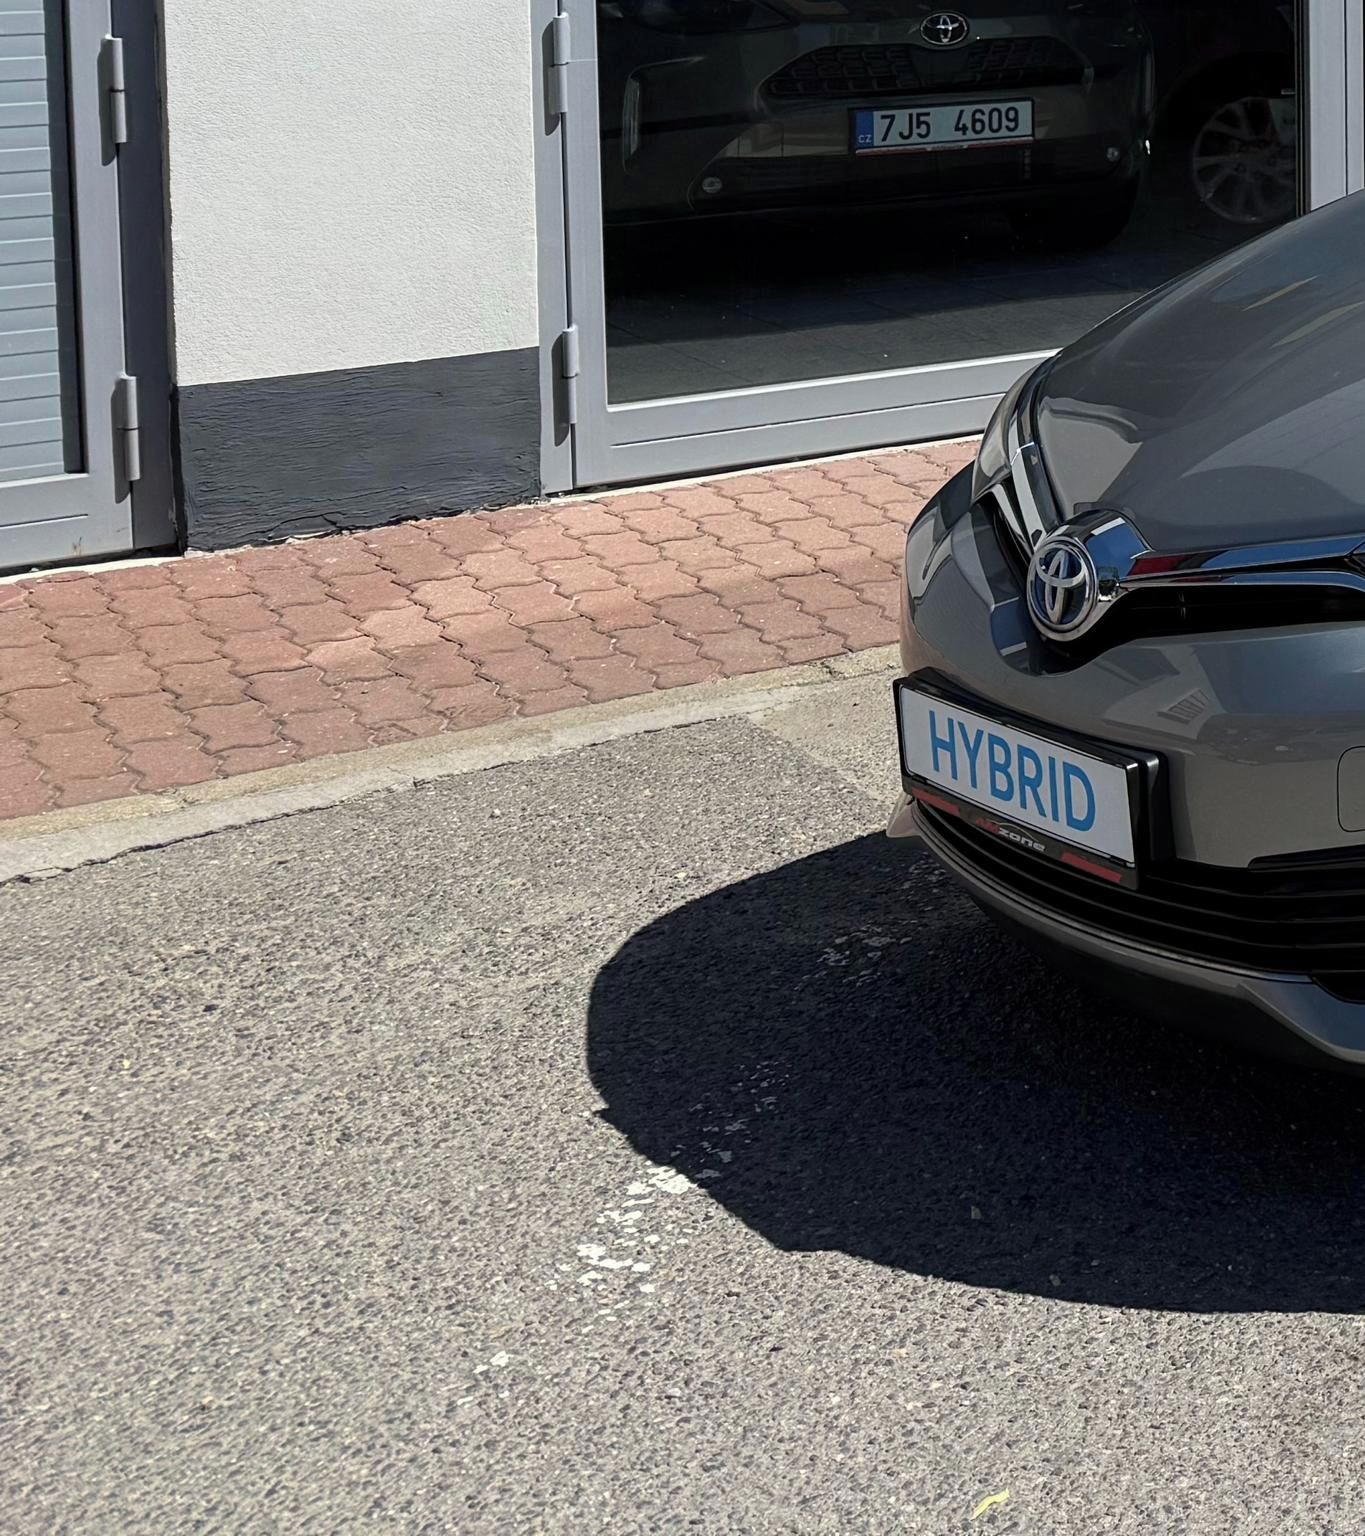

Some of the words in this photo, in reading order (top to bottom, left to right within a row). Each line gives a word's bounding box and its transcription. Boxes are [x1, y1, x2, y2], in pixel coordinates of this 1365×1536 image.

[858, 135, 872, 143] CZ
[880, 112, 931, 142] 7J5
[954, 106, 1020, 136] 4609
[928, 709, 1097, 833] HYBRID
